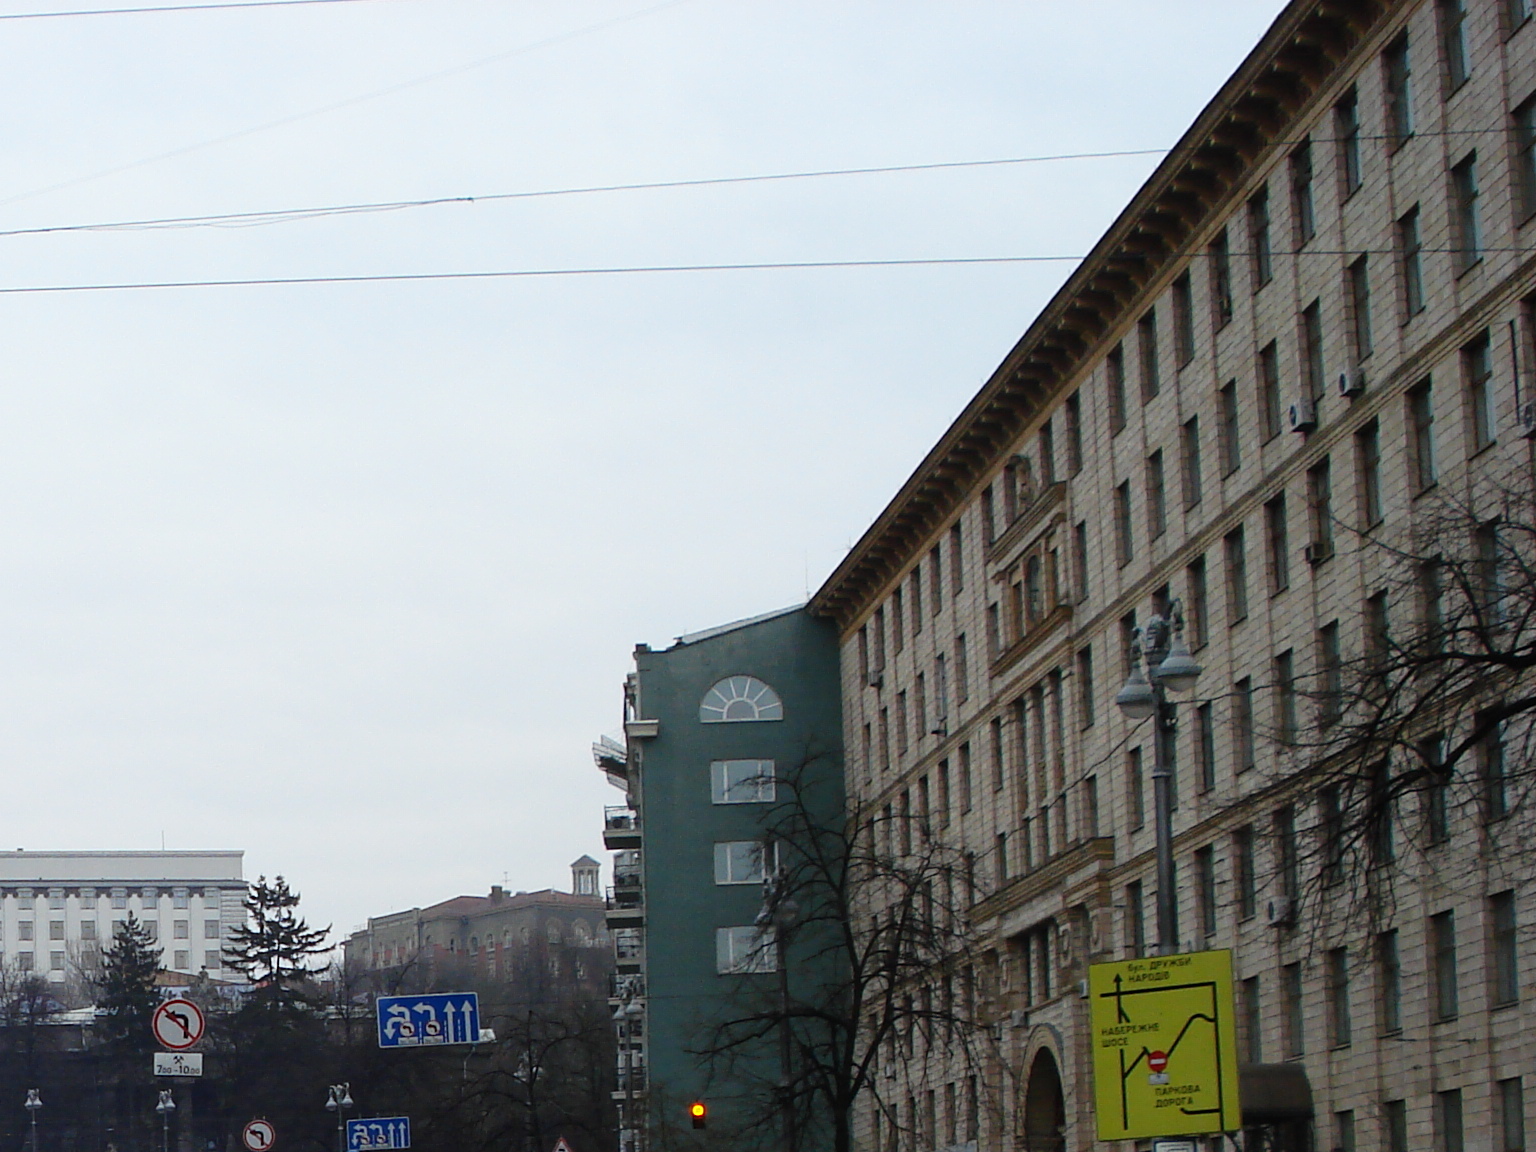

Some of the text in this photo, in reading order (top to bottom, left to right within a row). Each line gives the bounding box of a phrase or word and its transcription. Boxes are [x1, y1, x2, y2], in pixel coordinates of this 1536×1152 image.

[1150, 957, 1191, 971] ДРУЖБИ
[1101, 1023, 1160, 1036] НАБЕРЕЖНЕ
[1102, 1038, 1129, 1048] ШОСЕ
[1155, 1085, 1201, 1097] ПАРКОВА
[1154, 1097, 1194, 1109] ДОРОГА
